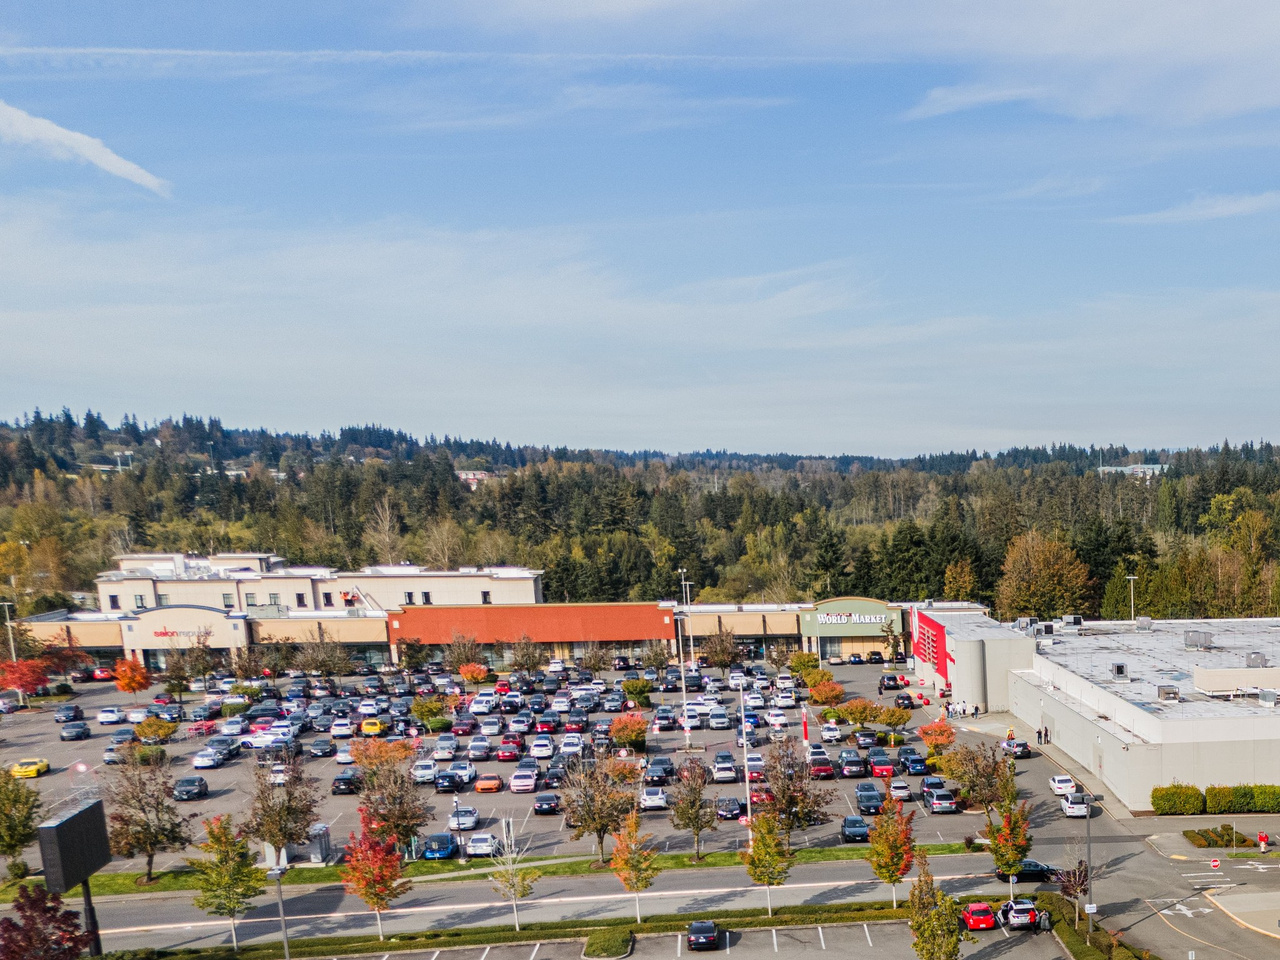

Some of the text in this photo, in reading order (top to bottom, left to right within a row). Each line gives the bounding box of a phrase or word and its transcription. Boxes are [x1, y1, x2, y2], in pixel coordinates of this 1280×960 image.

[817, 613, 849, 624] WORLD
[851, 613, 887, 624] MARKET
[153, 626, 178, 637] salon
